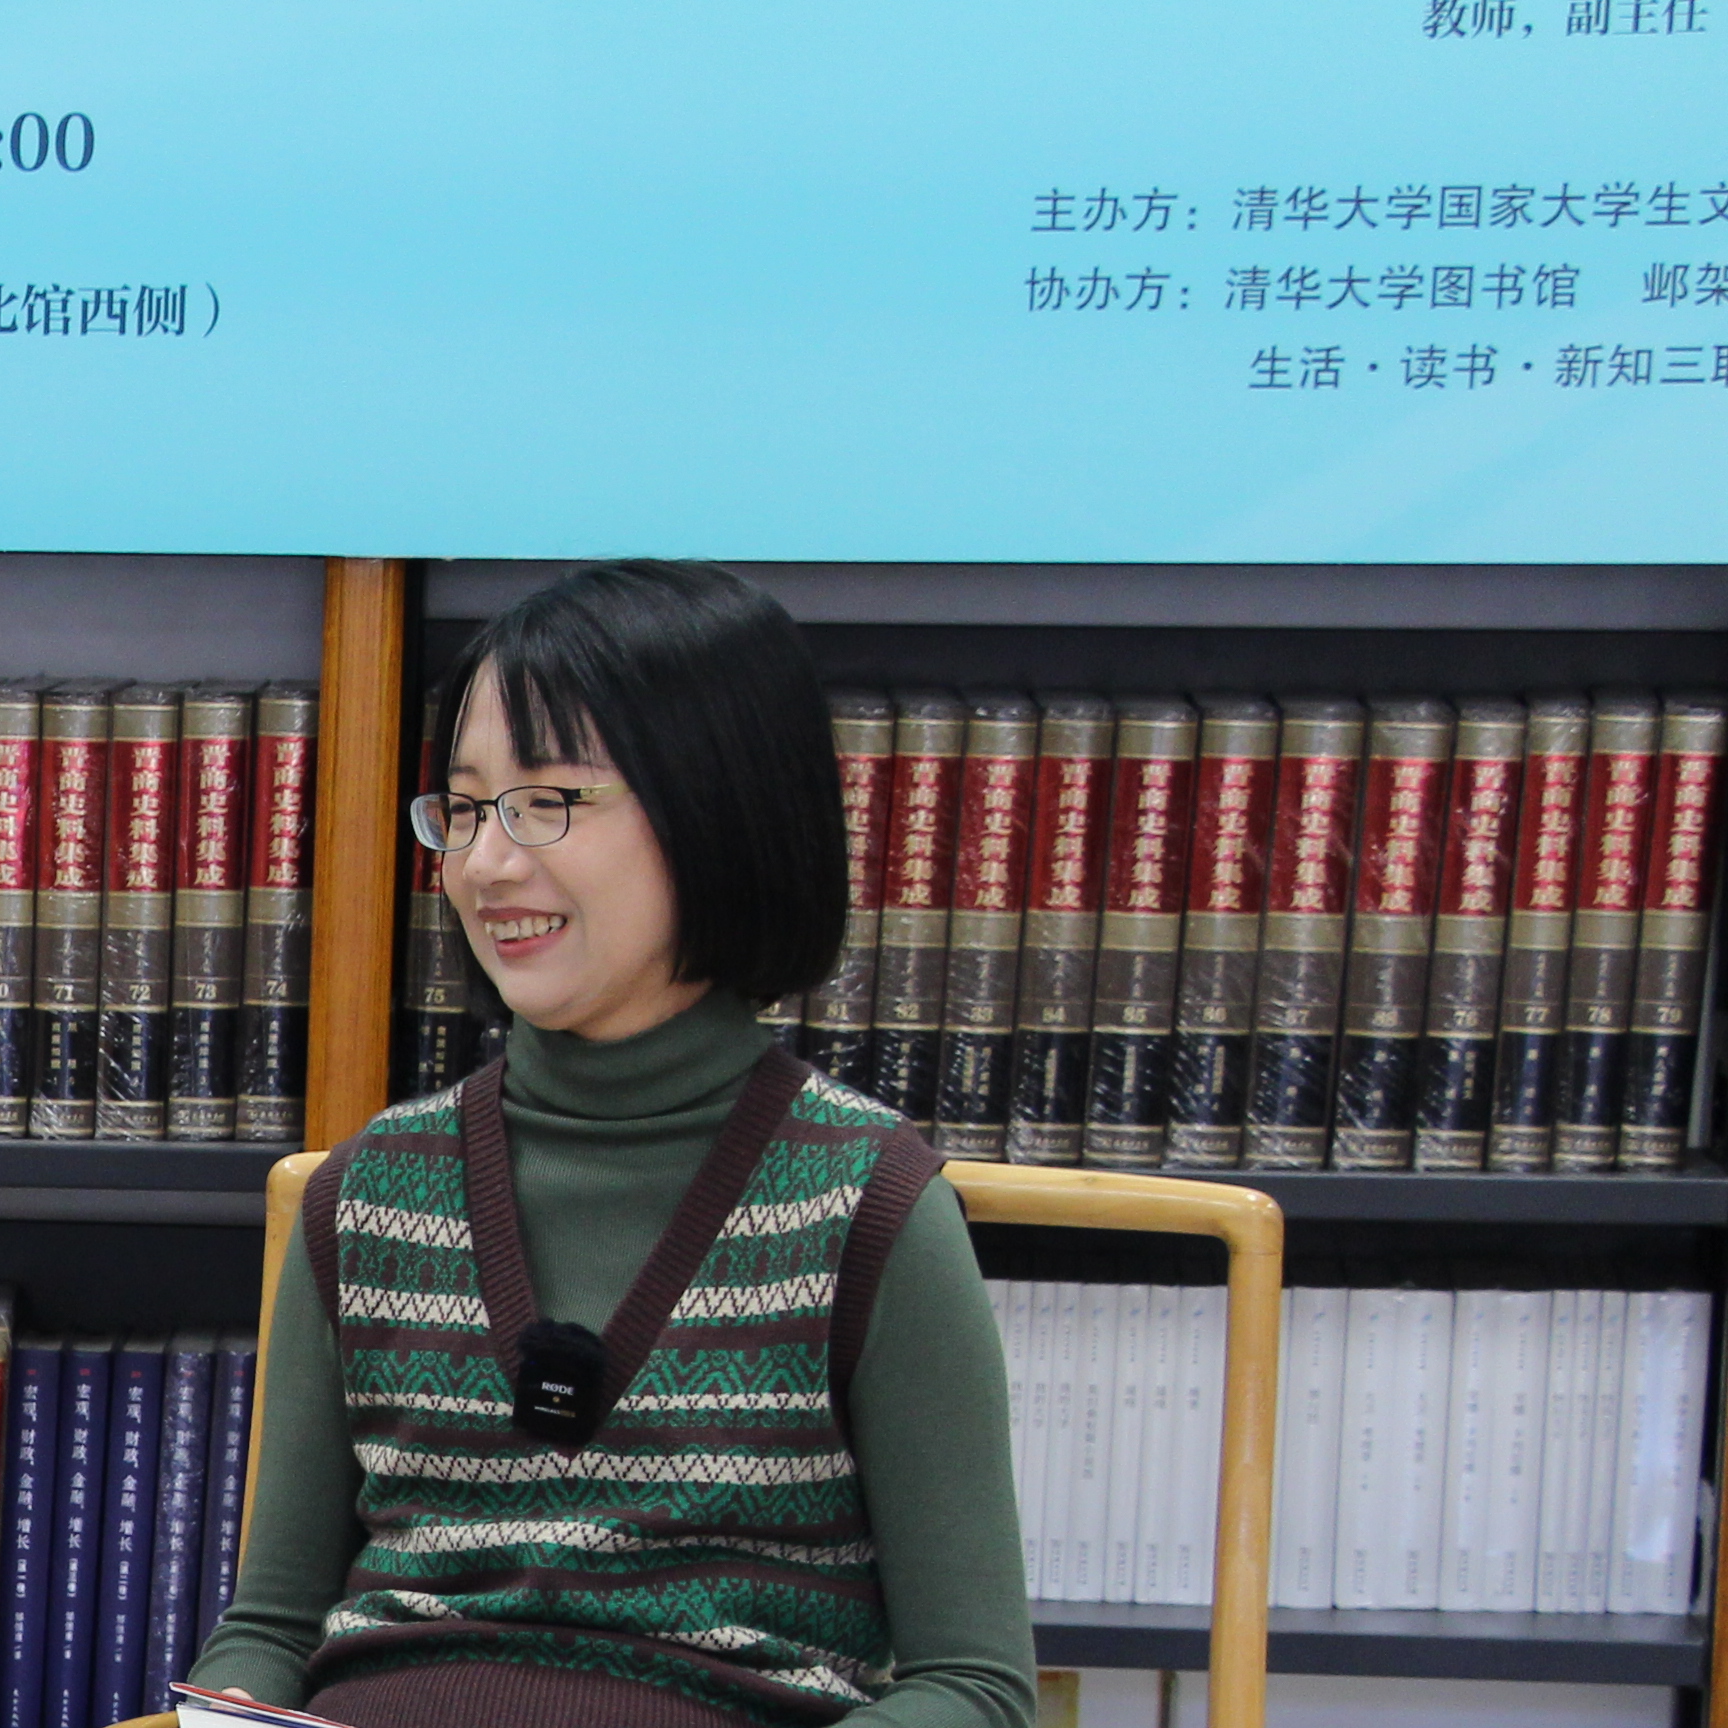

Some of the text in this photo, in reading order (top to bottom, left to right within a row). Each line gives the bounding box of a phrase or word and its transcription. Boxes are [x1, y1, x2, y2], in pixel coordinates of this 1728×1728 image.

[1025, 263, 1581, 311] 协办方：清华大学图书馆
[53, 744, 88, 889] 晋商史料集成
[124, 744, 162, 889] 晋商史料集成
[191, 743, 228, 888] 晋商史料集成
[266, 740, 303, 887] 晋商史料集成
[53, 982, 76, 1001] 71
[128, 982, 152, 1001] 72
[194, 982, 217, 1000] 73
[266, 980, 288, 998] 74
[424, 987, 445, 1002] 75
[1523, 1006, 1551, 1024] 77
[1586, 1006, 1613, 1024] 78
[1656, 1006, 1683, 1024] 79
